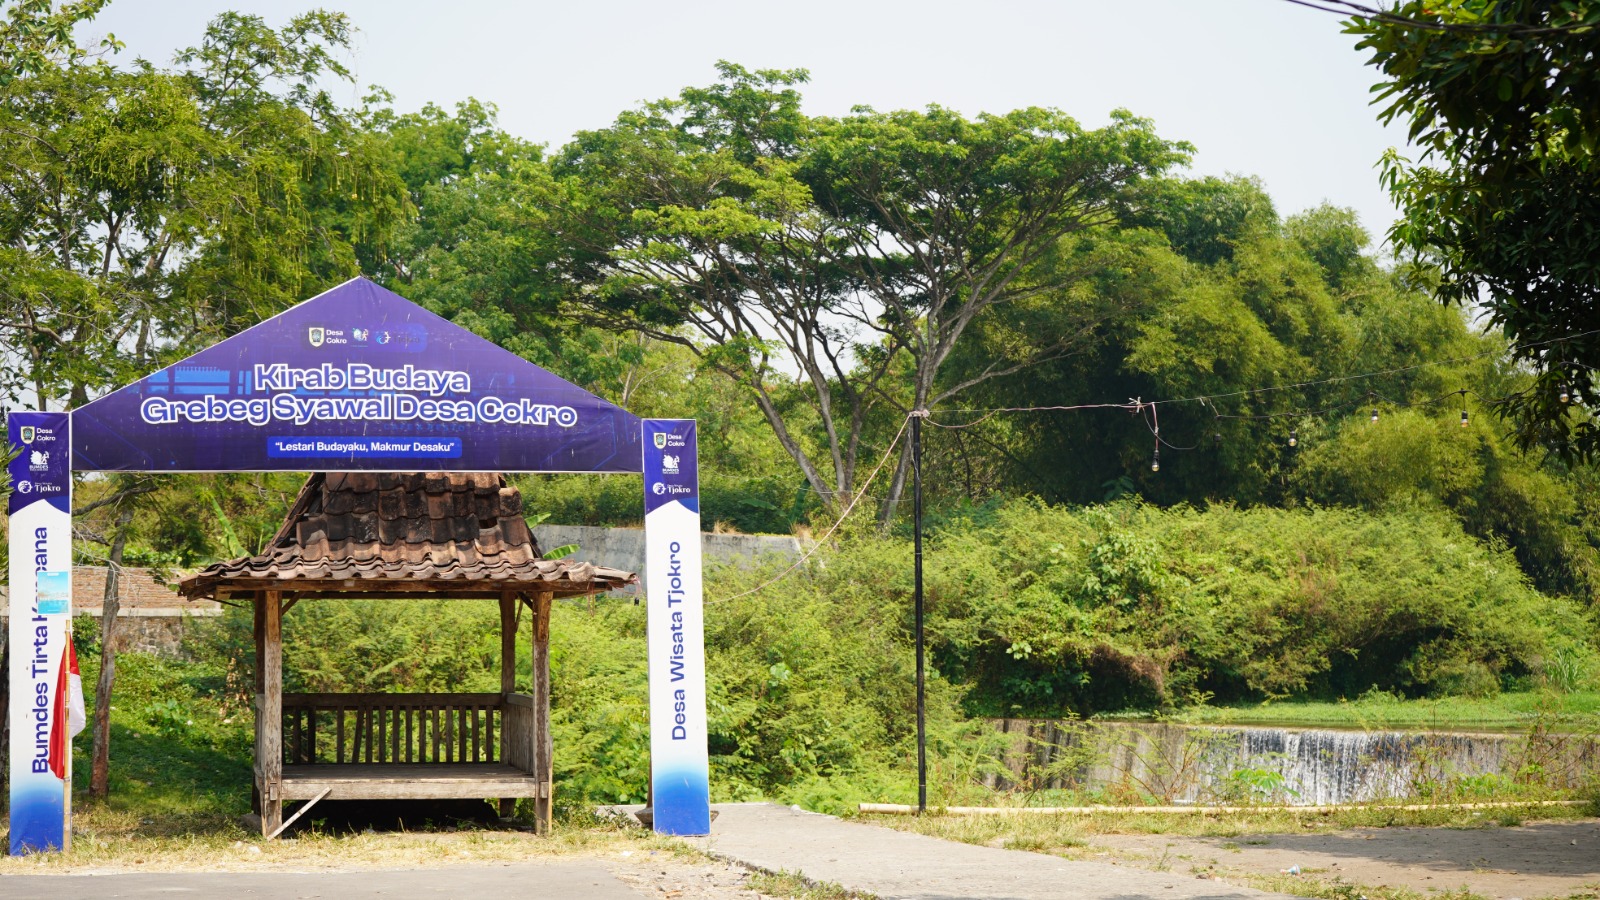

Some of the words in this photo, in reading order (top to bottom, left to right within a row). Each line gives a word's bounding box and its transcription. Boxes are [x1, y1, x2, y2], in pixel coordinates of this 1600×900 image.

[254, 363, 346, 391] Kirab
[348, 363, 471, 397] Budaya
[140, 394, 271, 426] Grebeg
[272, 393, 391, 426] Syawal
[393, 393, 475, 422] Desa
[477, 396, 578, 427] Cokro
[316, 441, 369, 453] Budayaku,
[370, 442, 411, 452] Makmur
[34, 484, 61, 493] Tjokro
[668, 486, 691, 494] Tjokro
[32, 527, 48, 622] Kana
[667, 541, 684, 608] Tjokro
[32, 625, 48, 679] Tirta
[670, 611, 684, 683] Wisata
[32, 682, 48, 774] Bumdes
[671, 689, 686, 741] Desa
